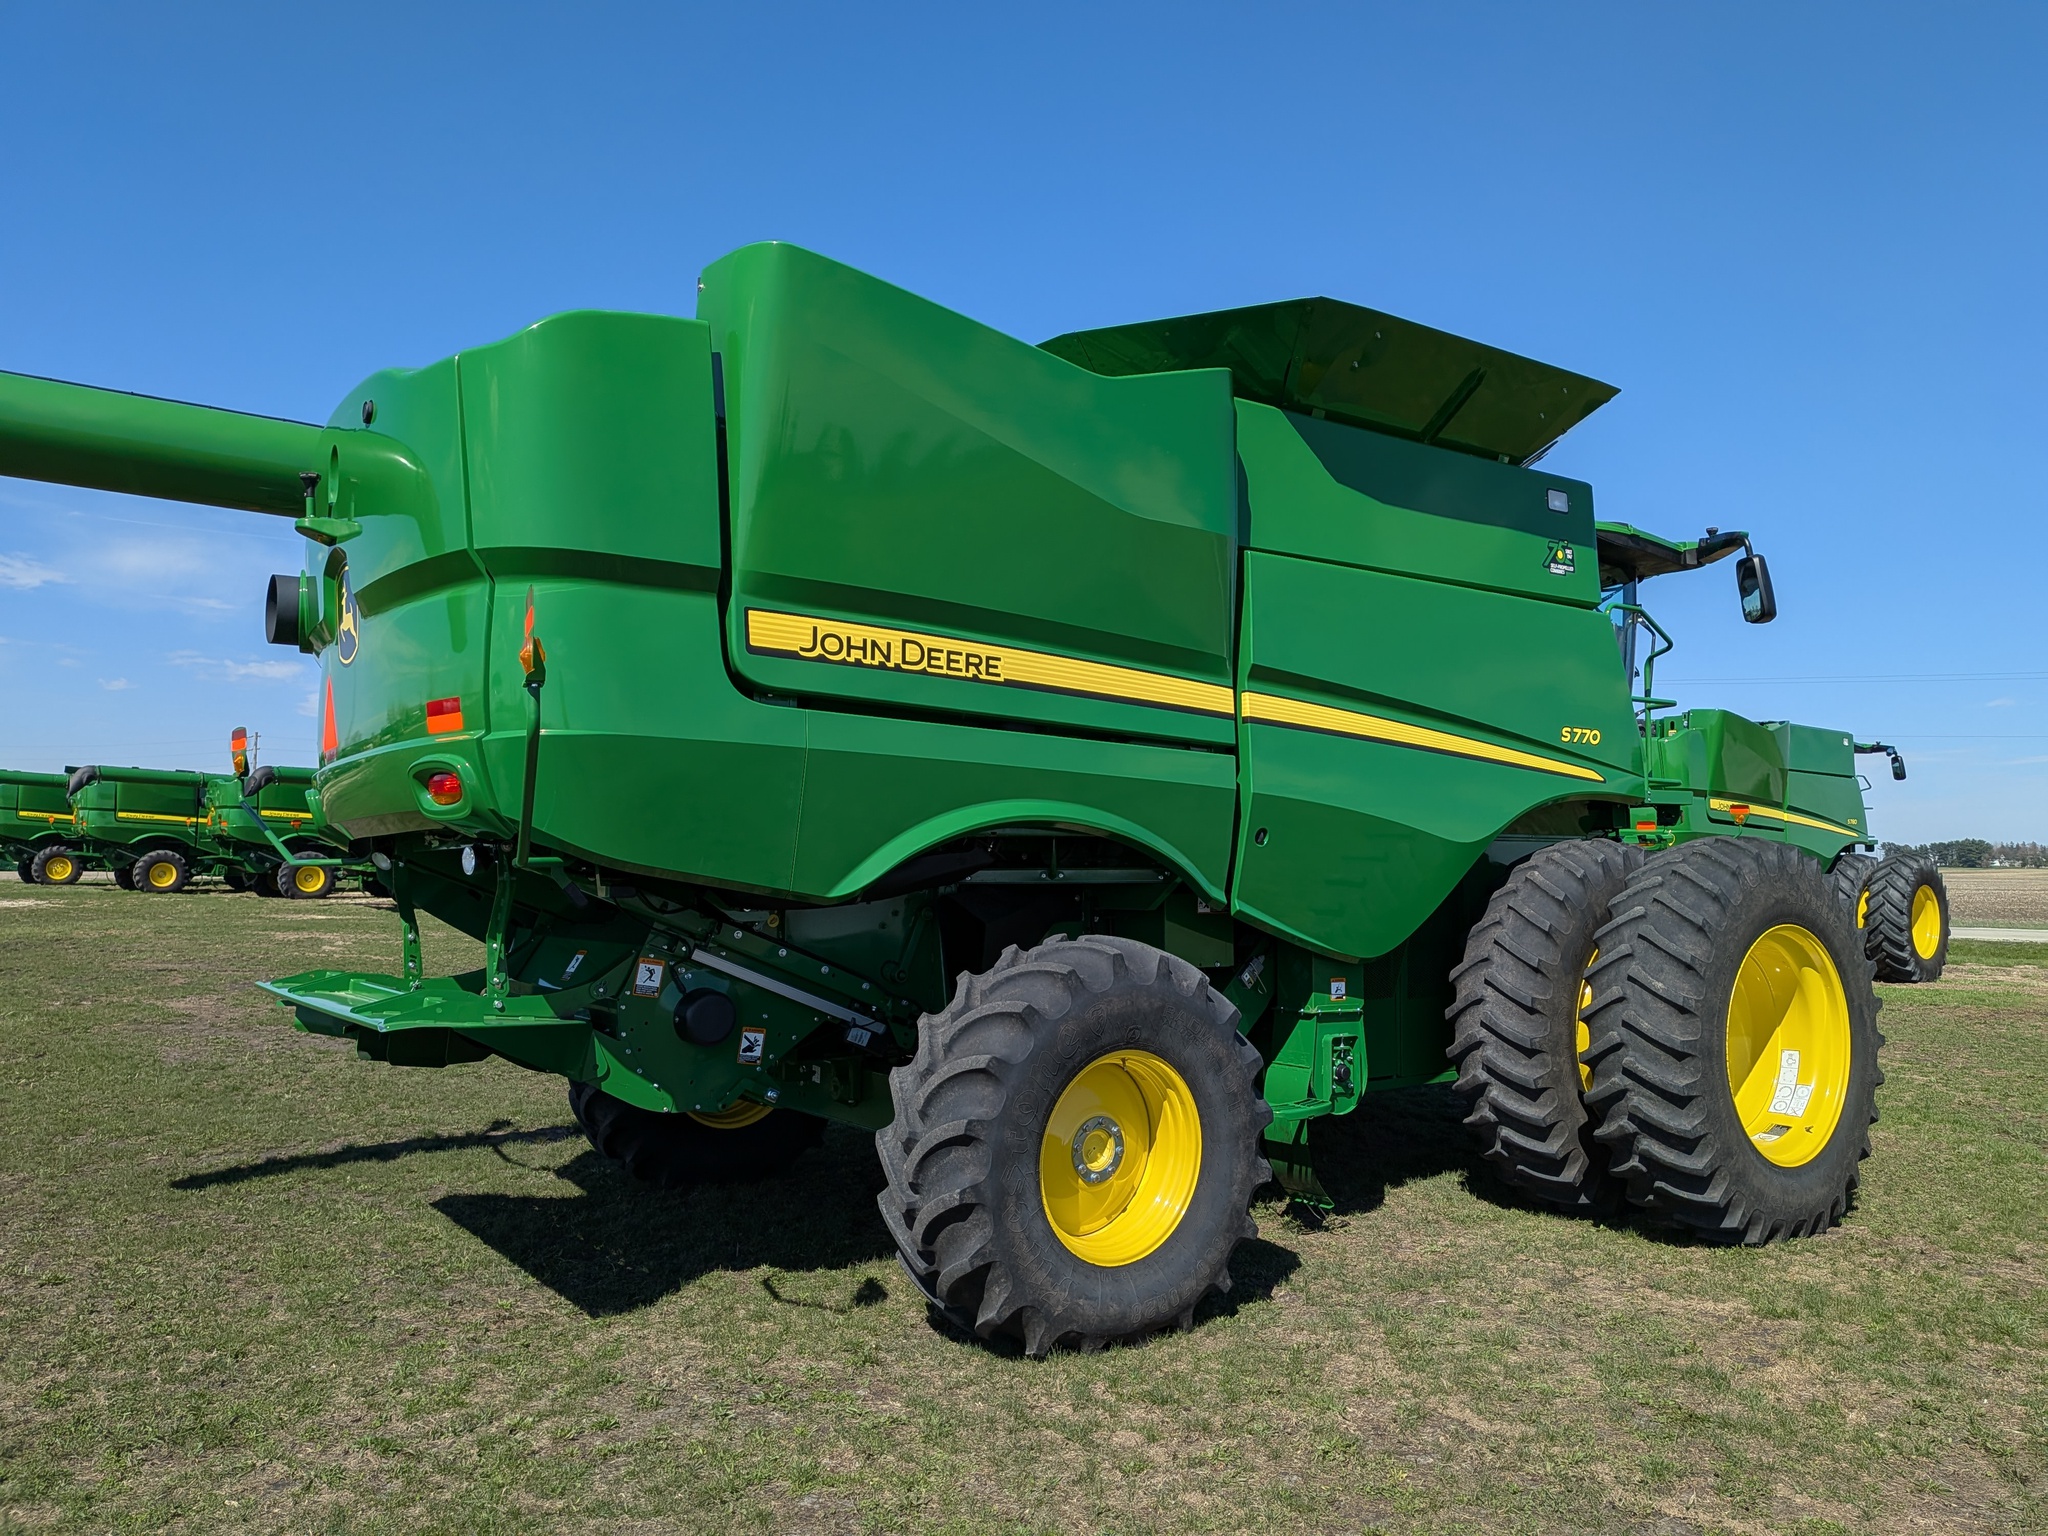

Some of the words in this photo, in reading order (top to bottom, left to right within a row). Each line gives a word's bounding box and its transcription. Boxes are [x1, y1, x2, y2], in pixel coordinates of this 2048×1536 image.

[799, 625, 892, 664] JOHN
[900, 638, 1002, 678] DEERE
[1560, 726, 1602, 746] S770
